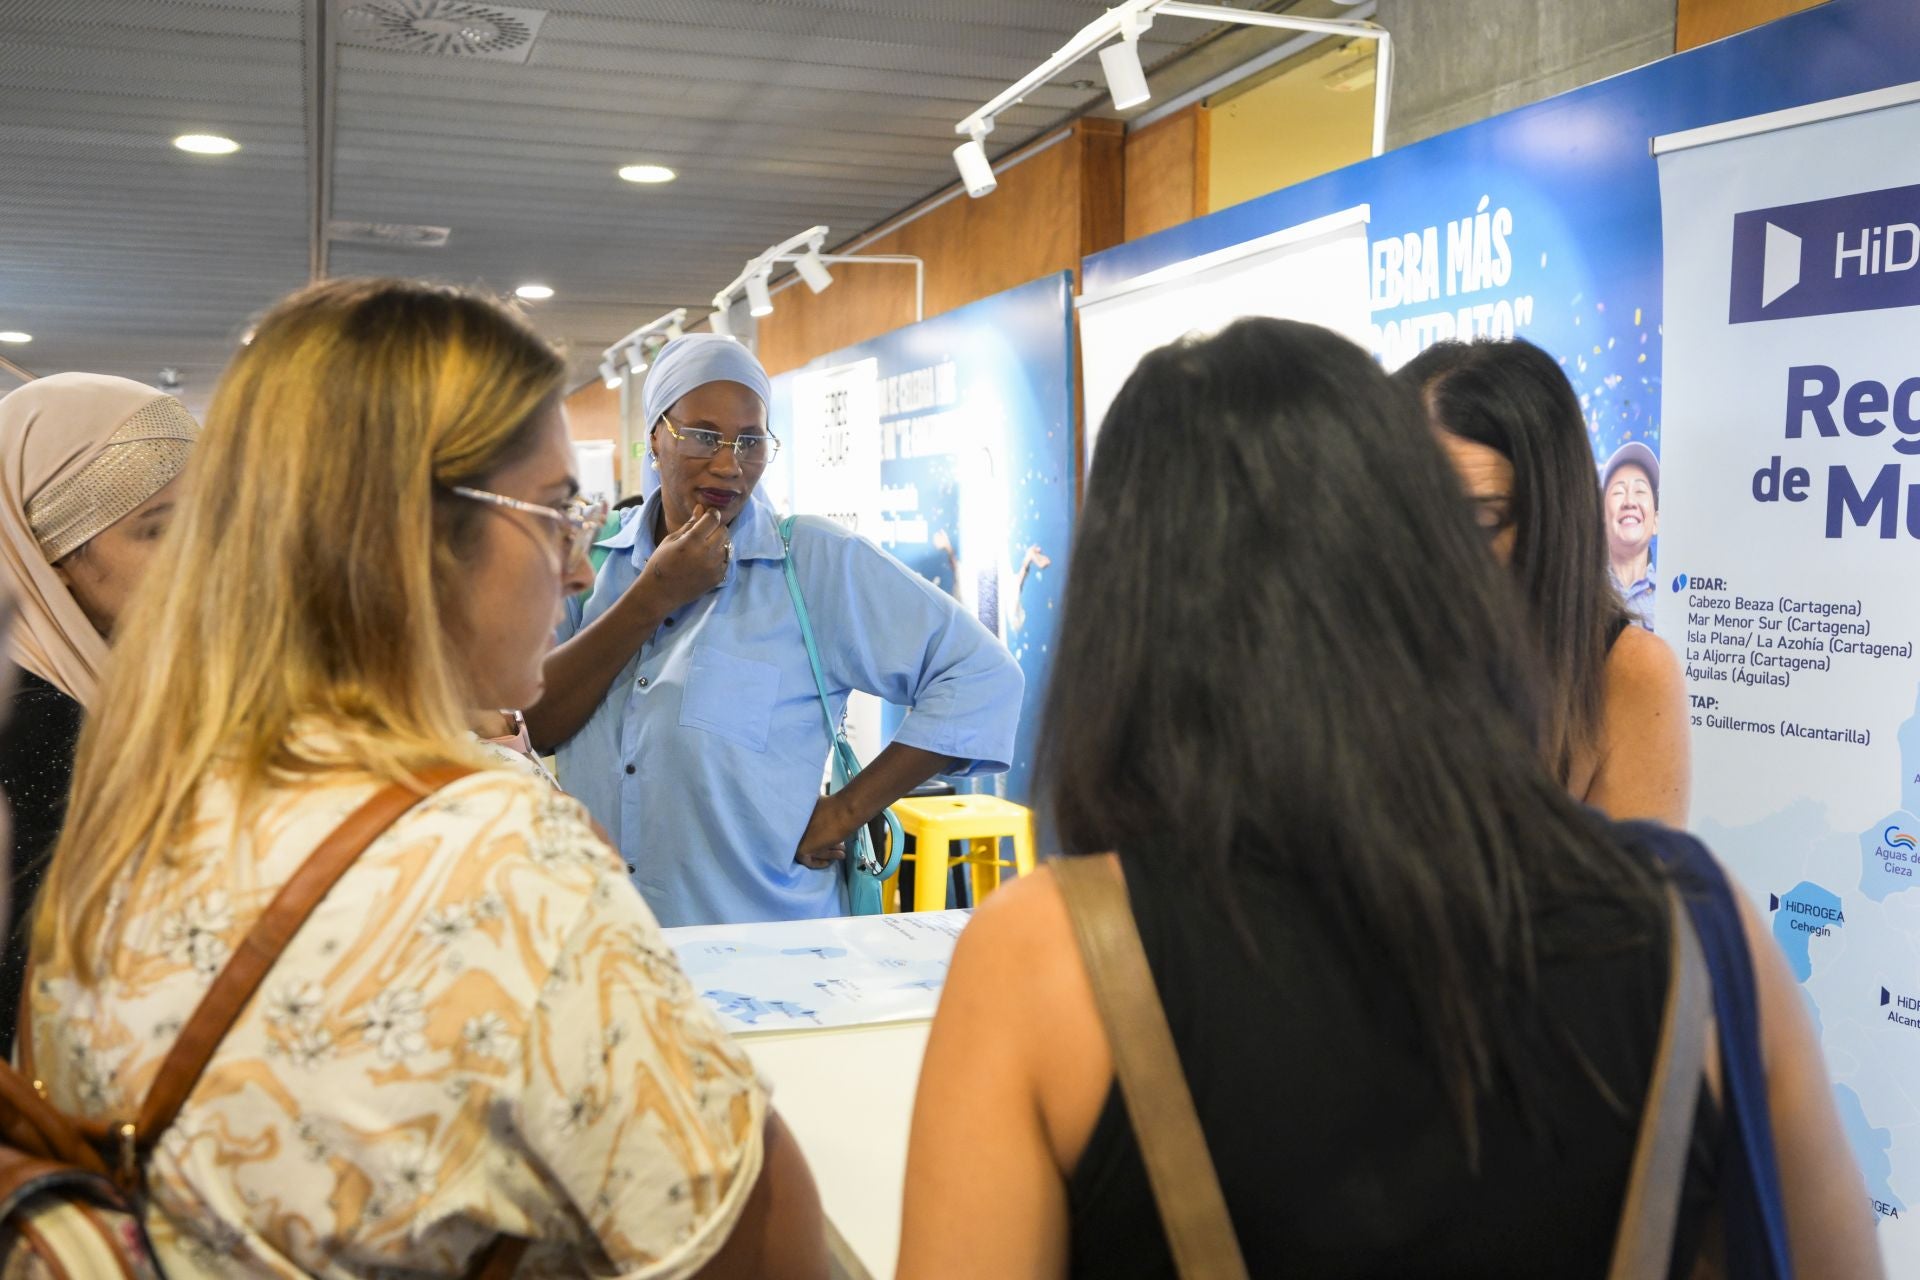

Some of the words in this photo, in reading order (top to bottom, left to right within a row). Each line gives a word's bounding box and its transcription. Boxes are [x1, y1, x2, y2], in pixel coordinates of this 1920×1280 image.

[1446, 194, 1513, 296] MÁS
[1752, 456, 1810, 502] de
[1690, 577, 1727, 591] EDAR:
[1689, 595, 1731, 609] Cabezo
[1735, 597, 1774, 611] Beaza
[1779, 597, 1862, 617] (Cartagena)
[1688, 613, 1711, 626] Mar
[1714, 614, 1755, 629] Menor
[1759, 616, 1783, 630] Sur
[1787, 616, 1870, 637] (Cartagena)
[1687, 630, 1707, 644] Isla
[1710, 632, 1753, 648] Plana/
[1757, 635, 1773, 648] La
[1777, 636, 1824, 651] Azohía
[1829, 637, 1913, 658] (Cartagena)
[1686, 648, 1699, 661] La
[1703, 649, 1745, 666] Aljorra
[1750, 651, 1830, 672] (Cartagena)
[1685, 665, 1727, 681] Águilas
[1732, 666, 1790, 687] (Águilas)
[1706, 714, 1775, 734] Guillermos
[1780, 721, 1870, 746] (Alcantarilla)
[1875, 846, 1907, 861] Aguas
[1884, 862, 1912, 877] Cieza
[1786, 900, 1845, 922] HiDROGEA
[1871, 1199, 1898, 1220] GEA
